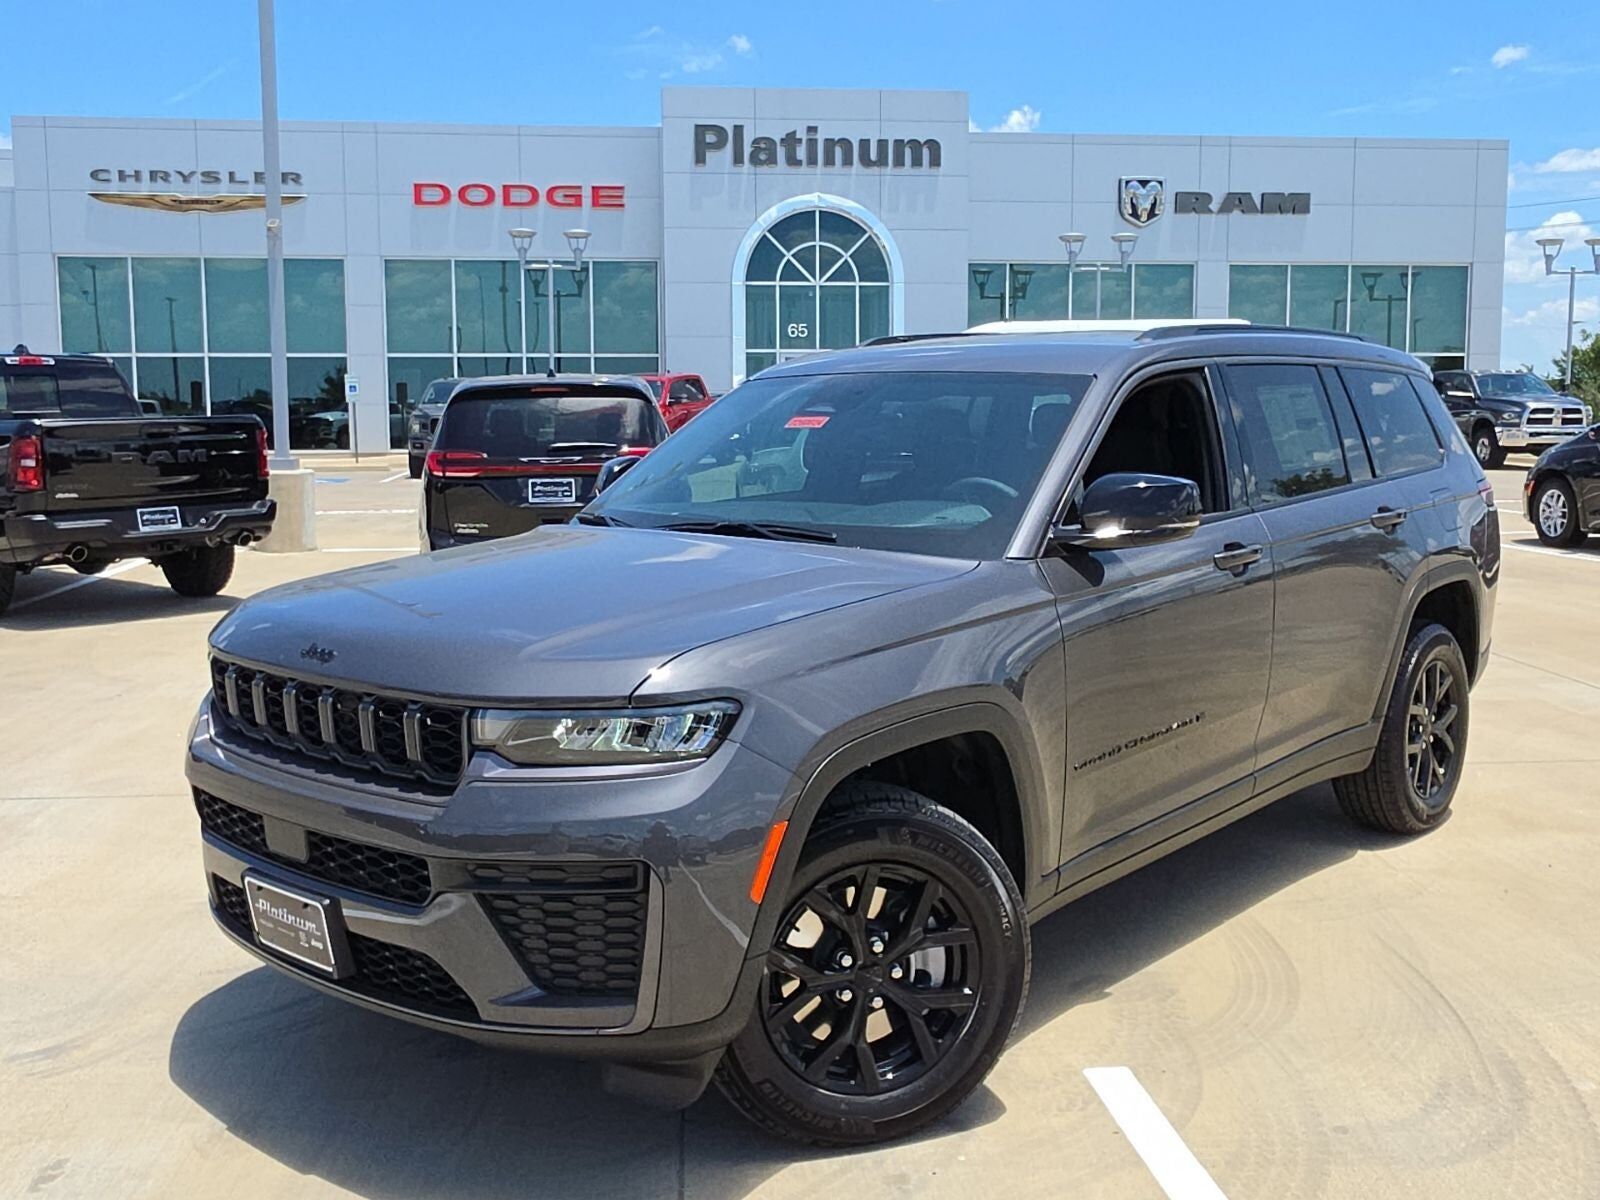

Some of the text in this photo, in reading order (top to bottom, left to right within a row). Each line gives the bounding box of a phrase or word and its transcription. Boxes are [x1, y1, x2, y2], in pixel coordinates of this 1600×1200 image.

[694, 124, 942, 168] Platinum
[89, 168, 303, 186] CHRYSLER
[413, 183, 625, 208] DODGE
[1175, 191, 1311, 214] RAM
[787, 323, 809, 338] 65
[255, 898, 321, 936] Platinum
